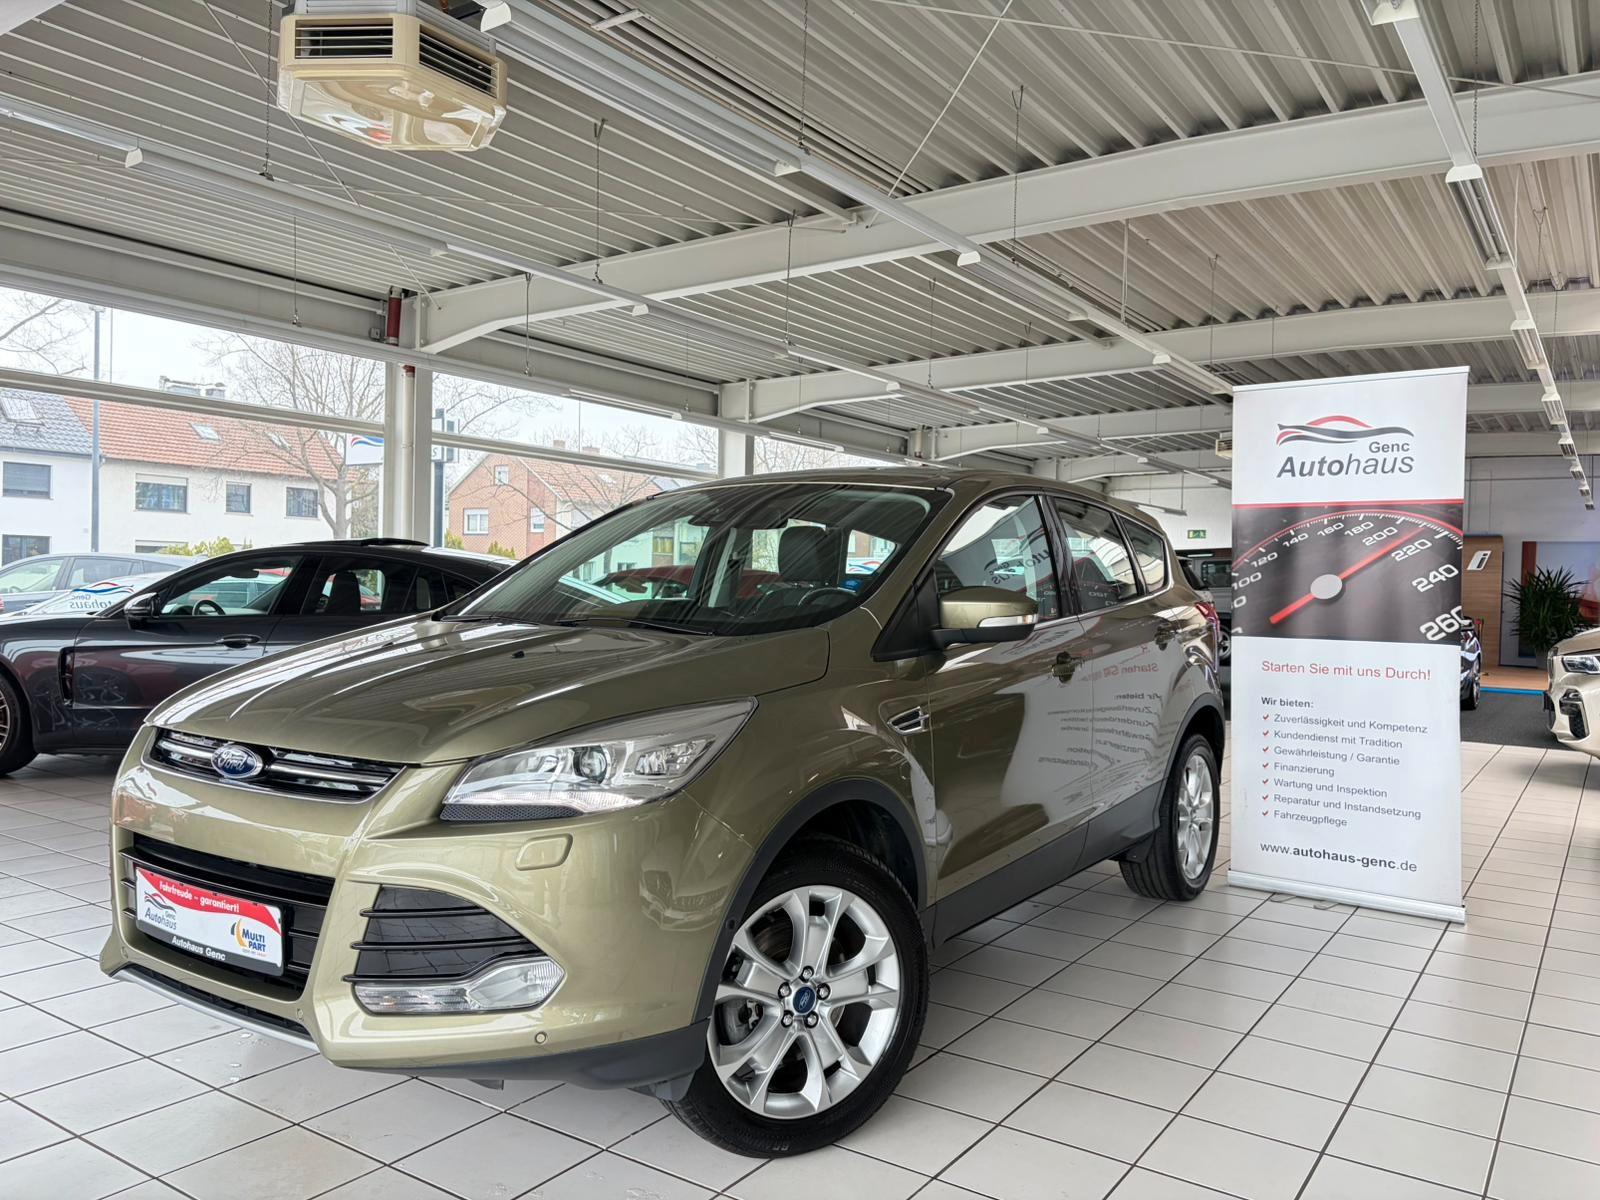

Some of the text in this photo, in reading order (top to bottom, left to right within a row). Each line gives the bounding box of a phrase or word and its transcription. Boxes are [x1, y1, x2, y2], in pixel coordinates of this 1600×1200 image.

[1369, 441, 1410, 453] Genc
[1276, 453, 1415, 478] Autohaus
[1317, 522, 1344, 536] 160
[1344, 521, 1374, 536] 180
[1362, 526, 1398, 546] 200
[1282, 532, 1309, 547] 140
[1250, 552, 1278, 567] 120
[1391, 539, 1432, 562] 220
[1232, 572, 1262, 590] 100
[1411, 564, 1459, 592] 240
[1231, 595, 1247, 609] 0
[1261, 660, 1431, 680] Starten Sie mit uns Durch!
[1261, 697, 1314, 708] Wir bieten:
[1274, 714, 1428, 735] Zuverlässigkeit und Kompetenz
[1274, 730, 1403, 748] Kundendienst mit Tradition
[1274, 746, 1348, 762] Gewährleistung
[1356, 753, 1400, 765] Garantie
[1274, 762, 1335, 777] Finanzierung
[1274, 778, 1388, 798] Wartung und Inspektion
[1274, 794, 1422, 820] Reparatur und Instandsetzung
[1274, 809, 1348, 827] Fahrzeugpflege
[1260, 842, 1418, 872] www.autohaus-genc.de
[144, 907, 177, 930] Autohaus
[242, 928, 265, 942] MULTI
[171, 935, 204, 954] Autohaus
[205, 947, 226, 961] Genc
[249, 940, 266, 952] PART
